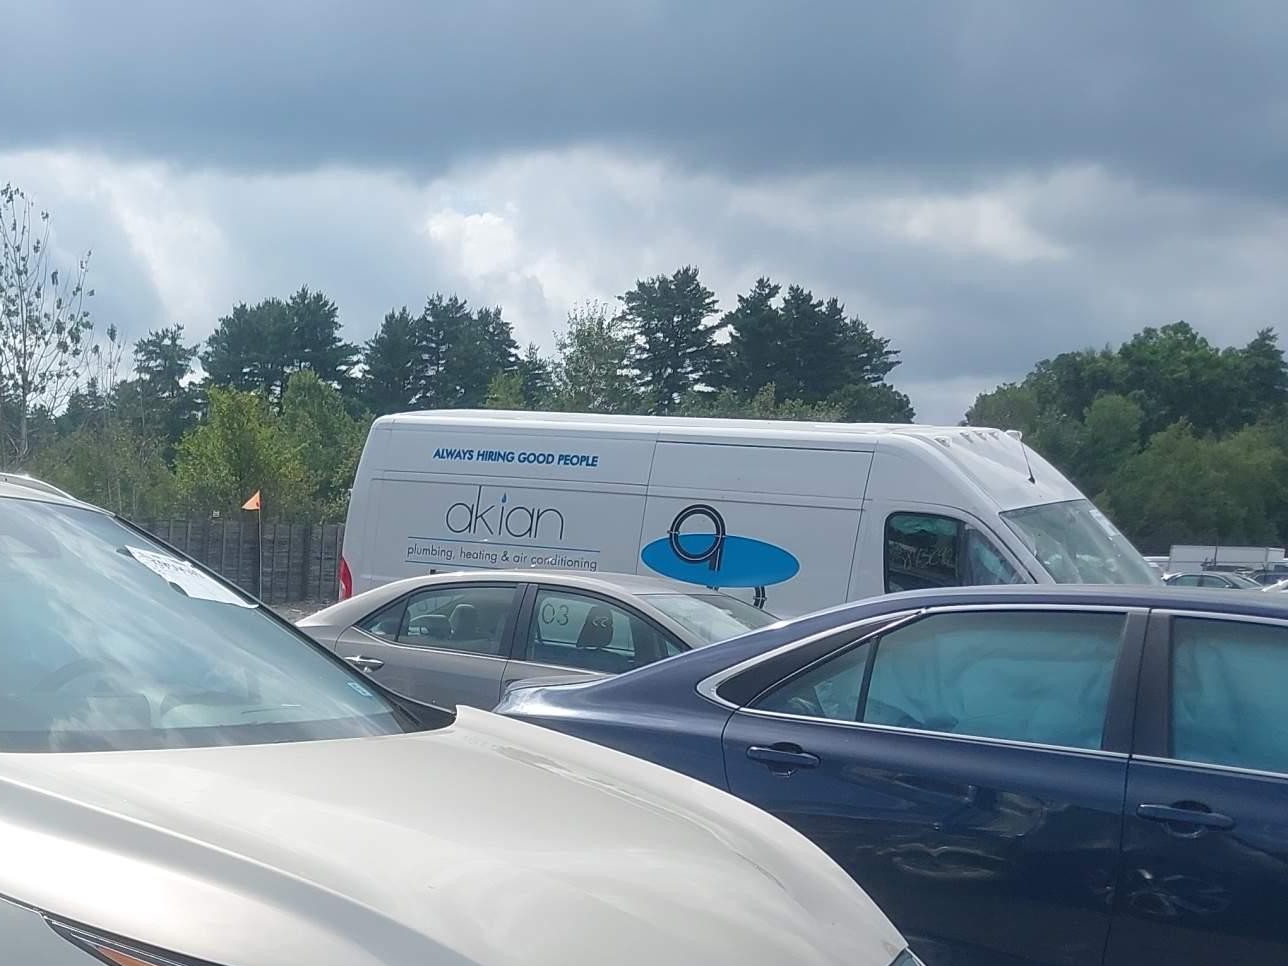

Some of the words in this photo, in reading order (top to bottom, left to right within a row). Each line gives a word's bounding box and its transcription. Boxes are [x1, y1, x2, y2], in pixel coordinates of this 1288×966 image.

[432, 447, 475, 461] ALWAYS
[476, 450, 515, 463] HIRING
[517, 452, 555, 465] GOOD
[557, 454, 599, 467] PEOPLE
[446, 485, 564, 540] akian
[407, 545, 456, 560] plumbing,
[460, 547, 498, 563] heating
[501, 552, 510, 562] &
[513, 552, 528, 563] air
[530, 555, 598, 572] conditioning
